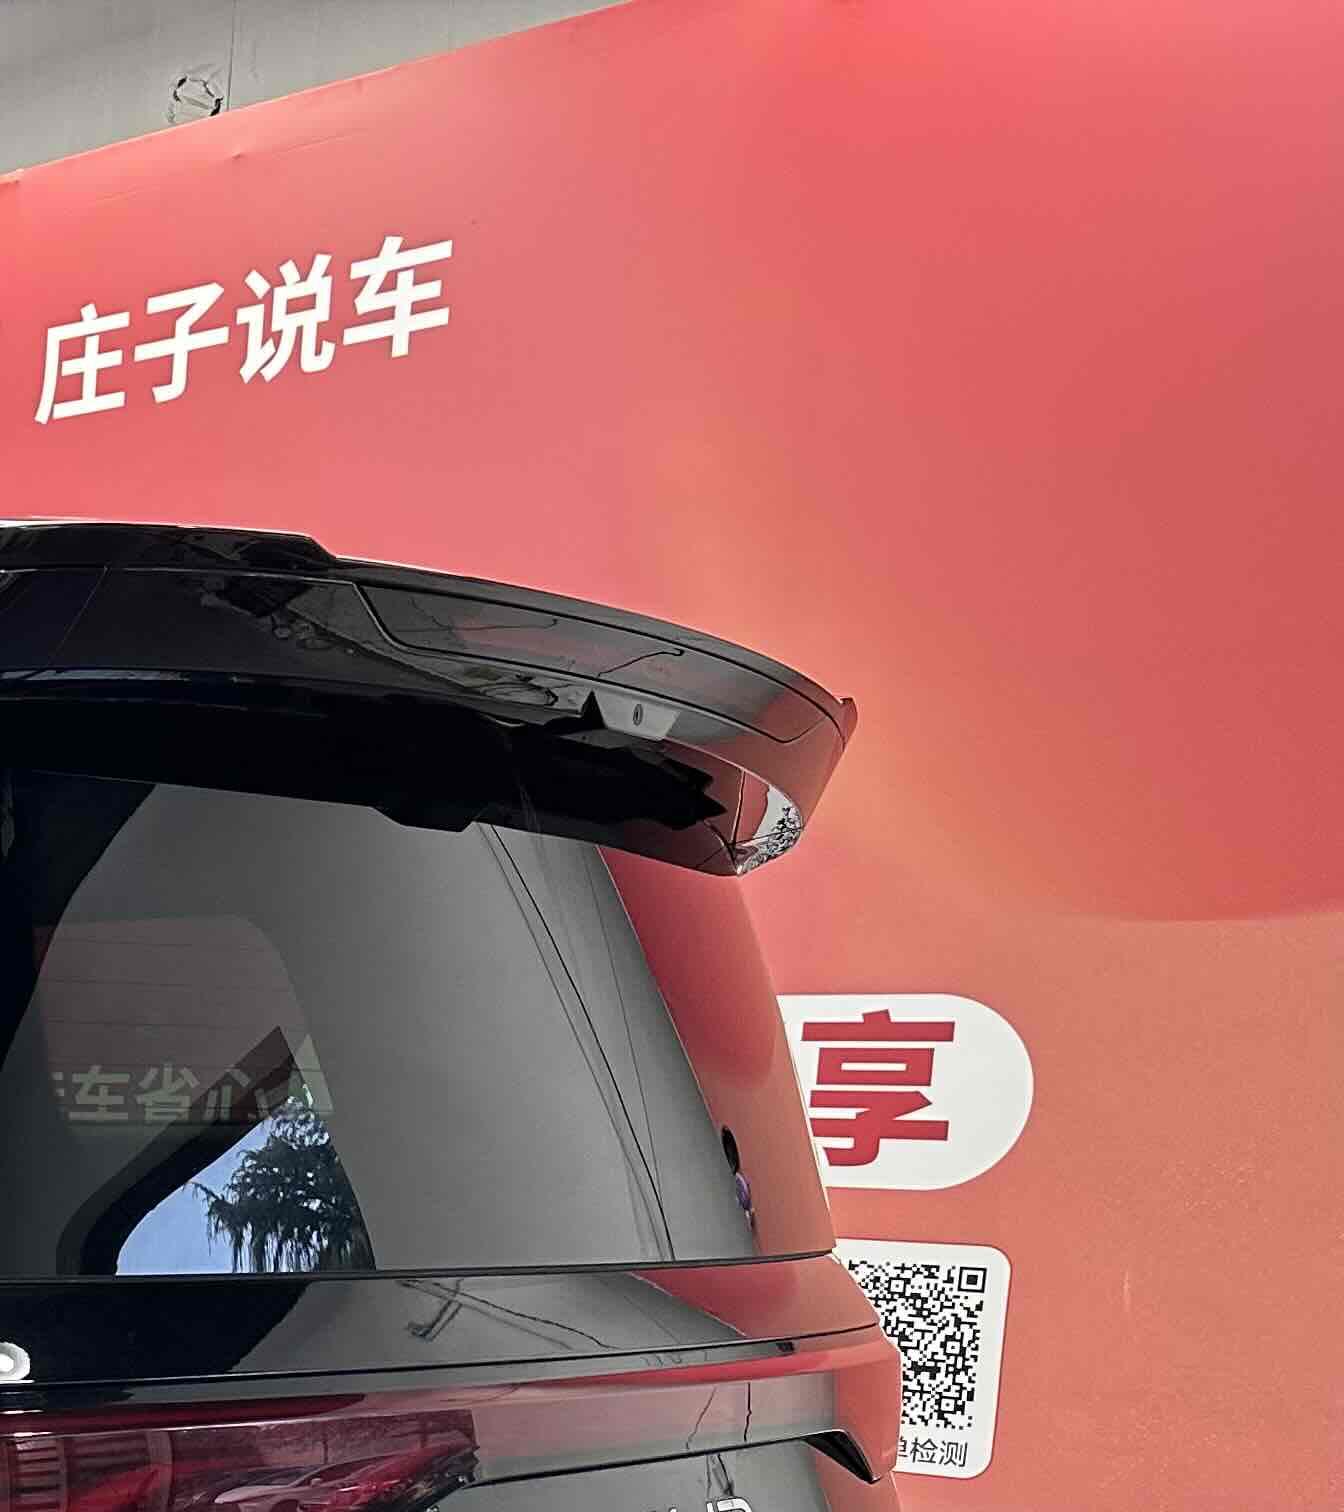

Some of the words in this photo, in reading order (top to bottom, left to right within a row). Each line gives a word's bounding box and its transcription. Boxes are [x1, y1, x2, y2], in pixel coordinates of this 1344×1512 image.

[35, 235, 454, 426] 庄子说车
[801, 1009, 955, 1167] 享
